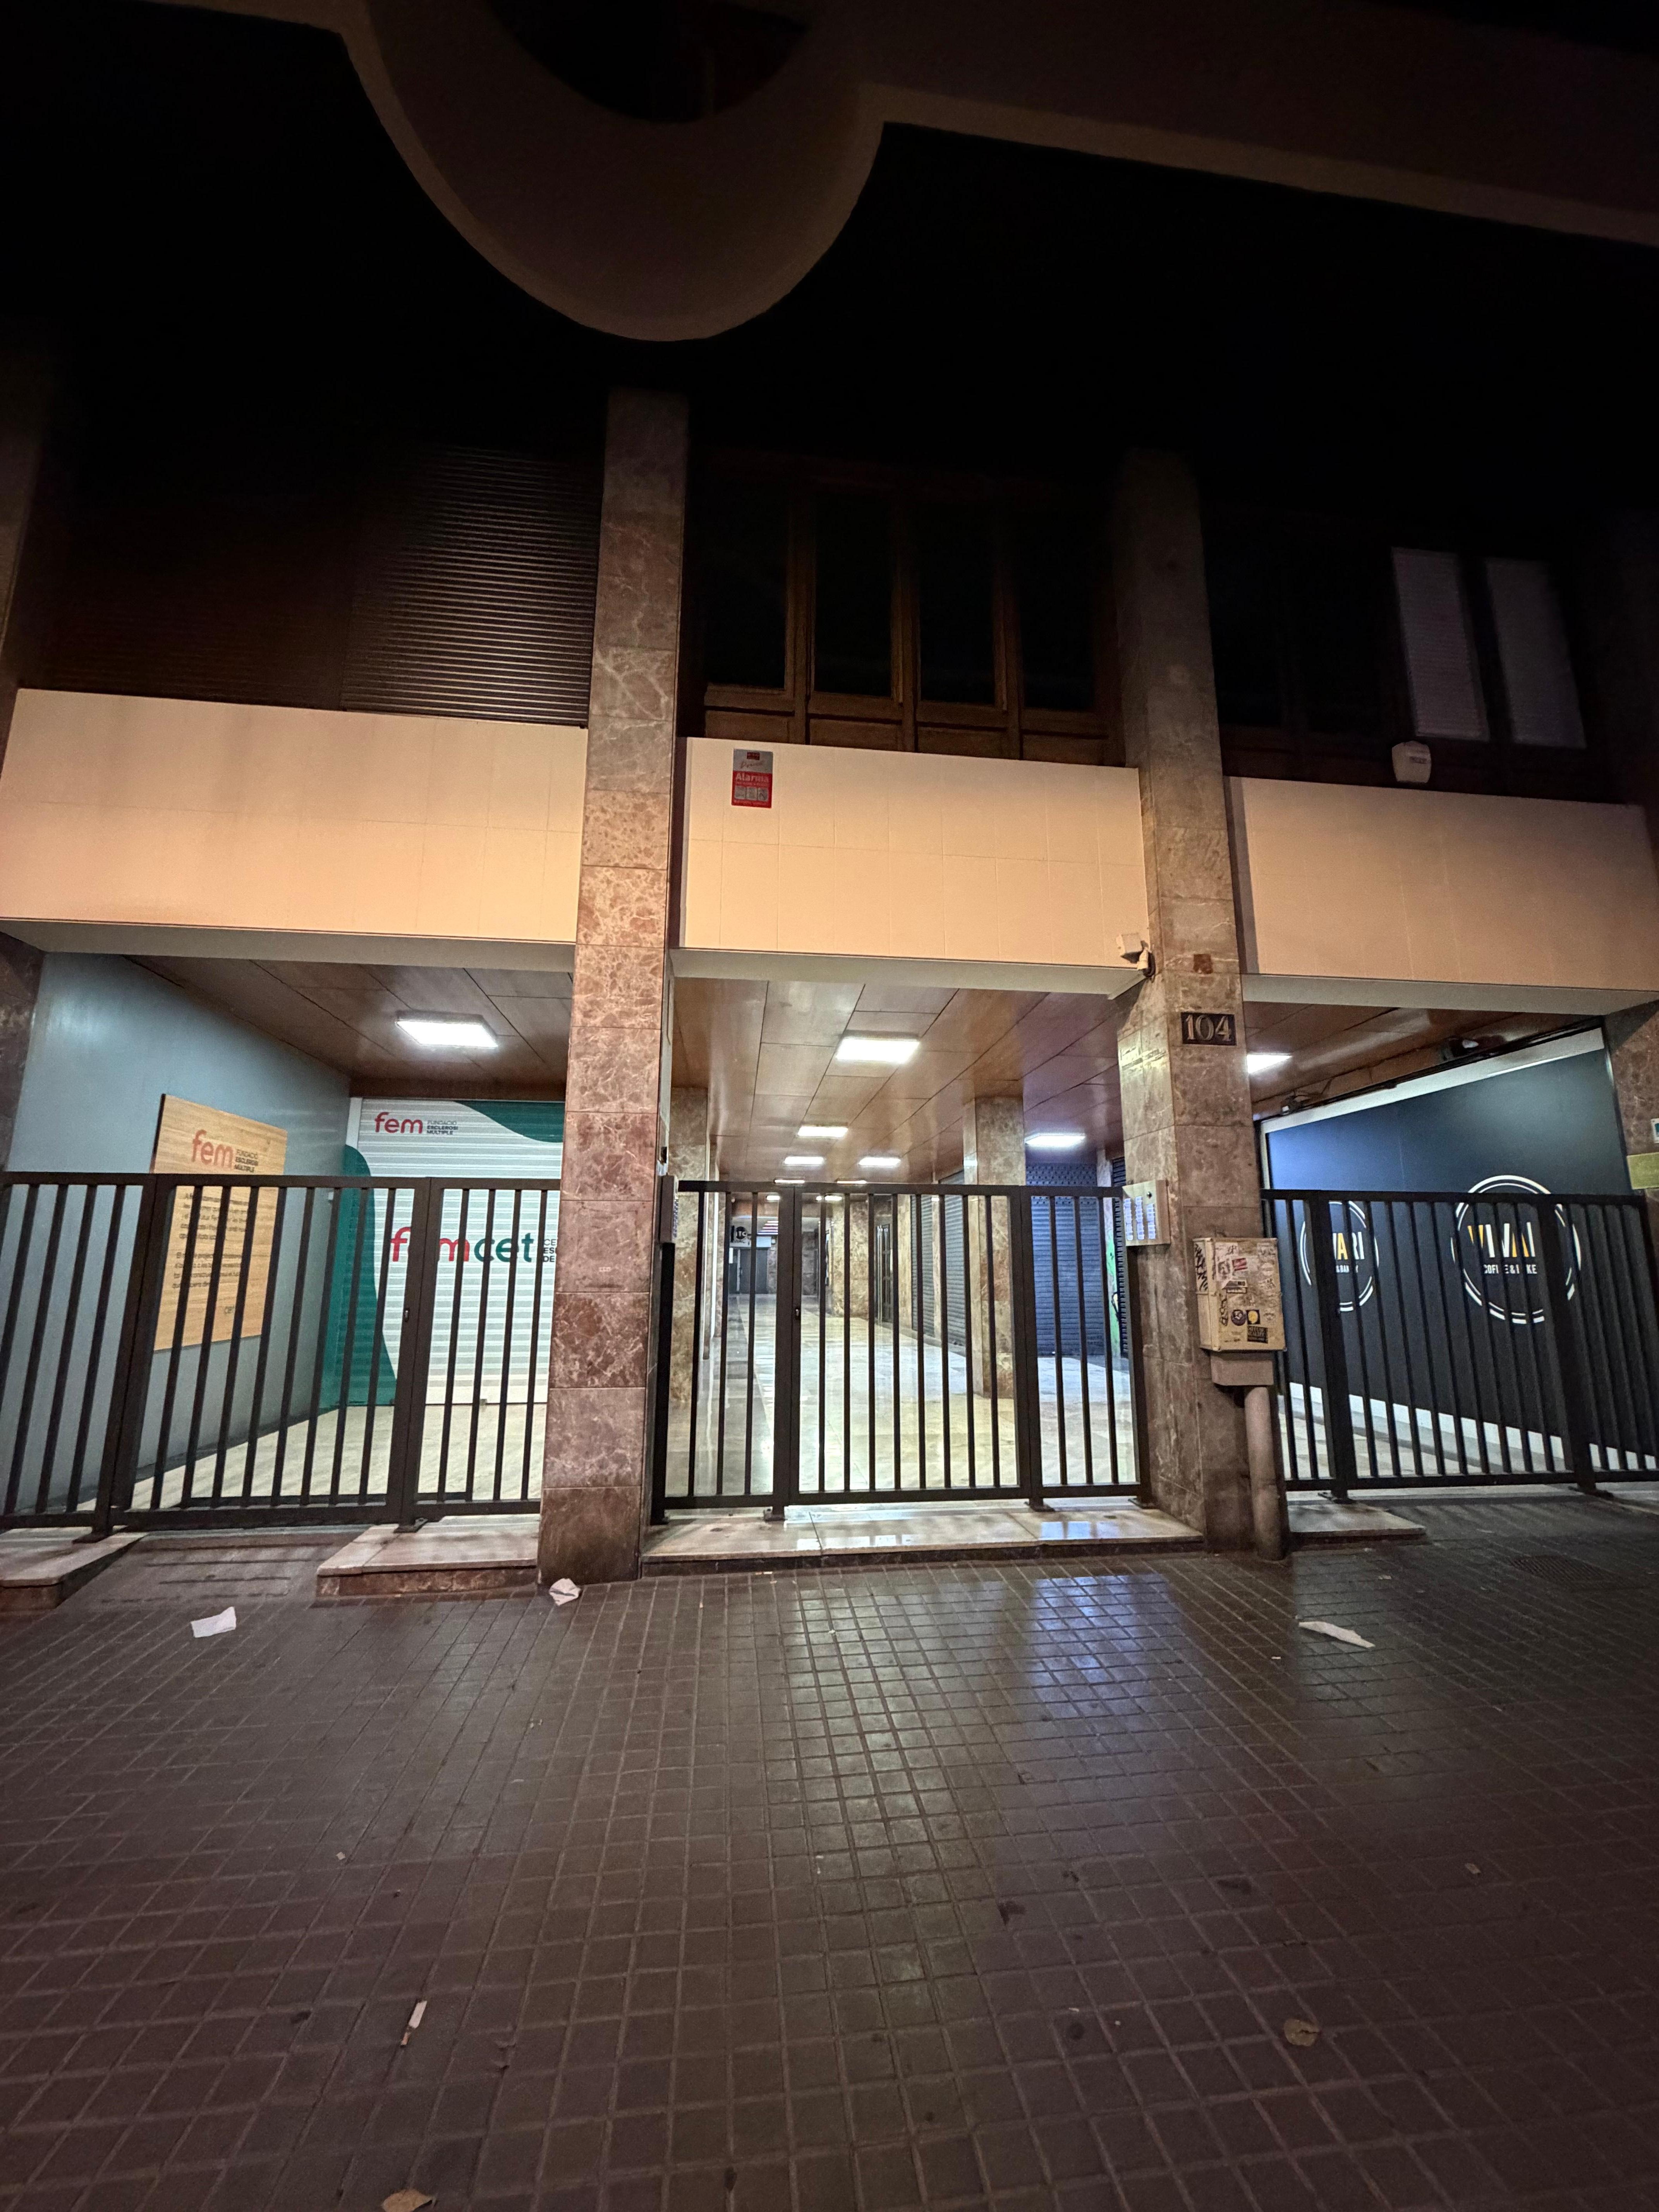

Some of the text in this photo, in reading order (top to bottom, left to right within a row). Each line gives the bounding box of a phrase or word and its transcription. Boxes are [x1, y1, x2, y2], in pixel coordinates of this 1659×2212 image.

[736, 773, 769, 782] Alarma
[1185, 1014, 1231, 1042] 104
[374, 1112, 423, 1134] fem
[191, 1129, 234, 1171] fem
[390, 1226, 534, 1262] fmcet
